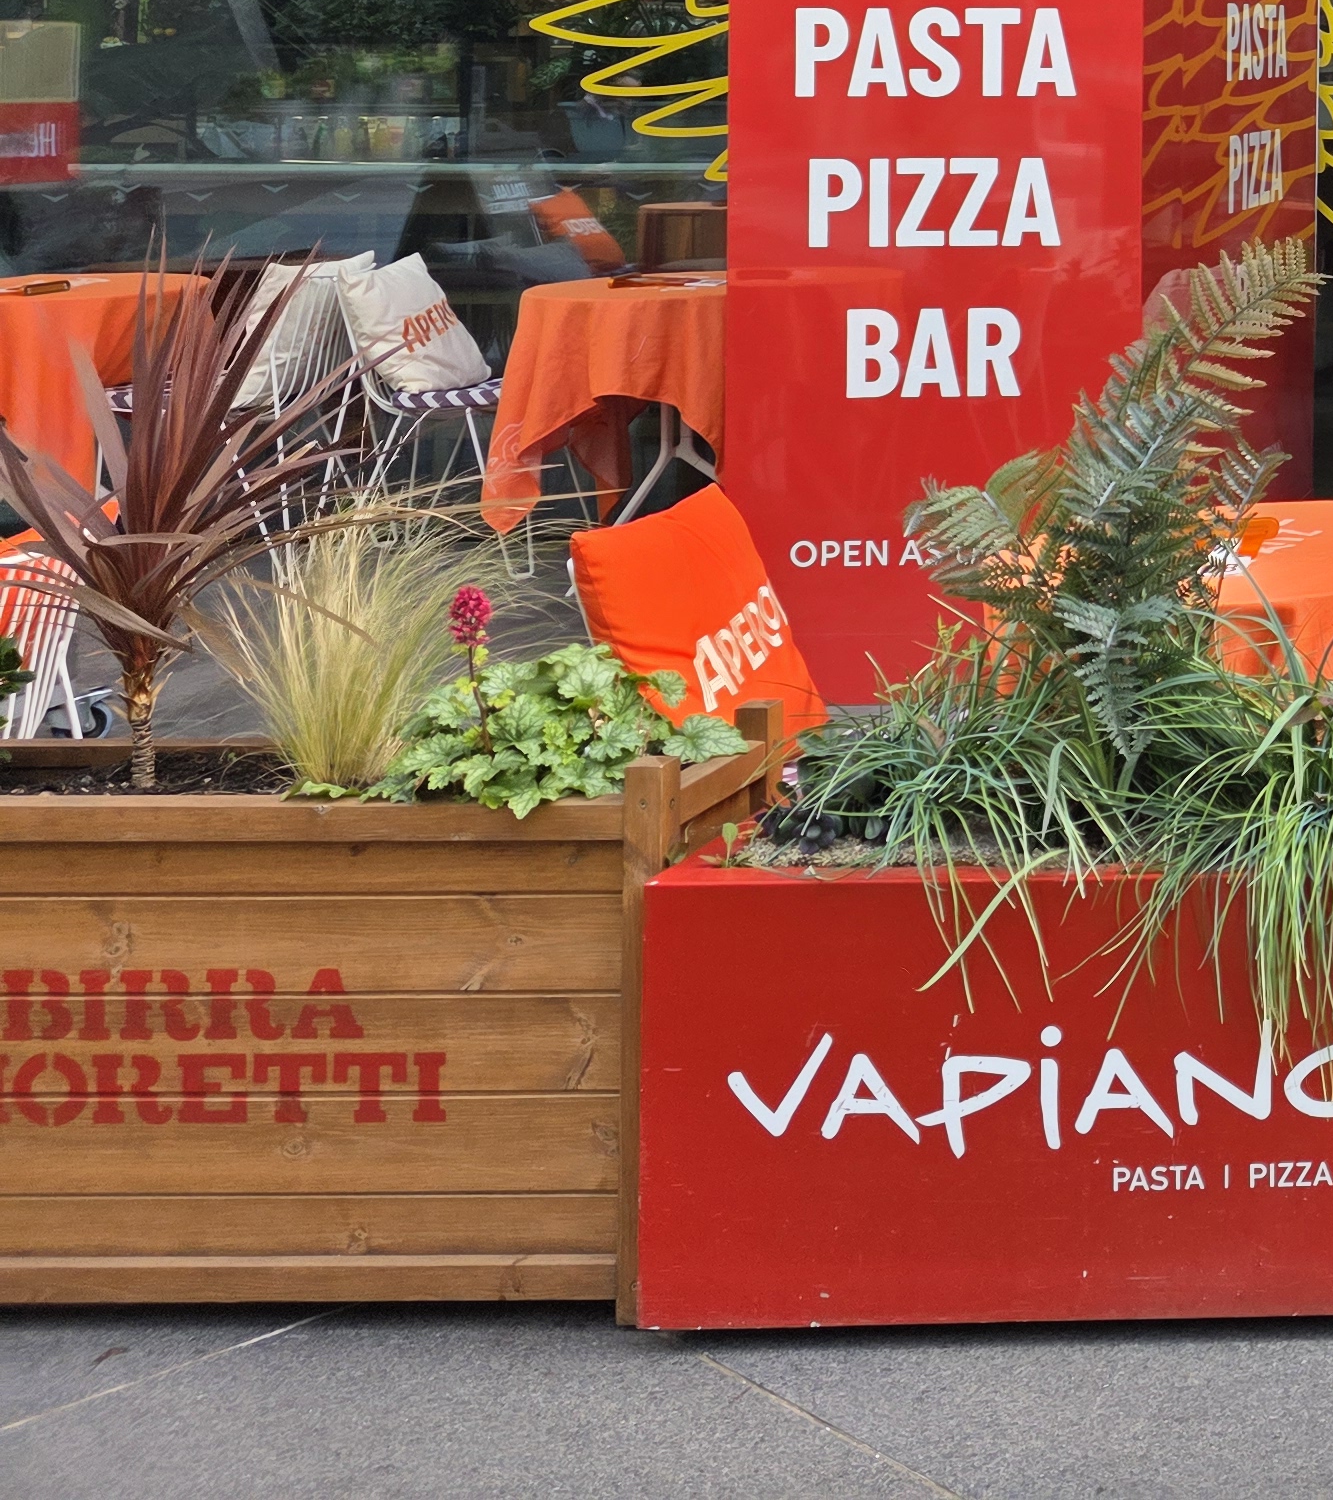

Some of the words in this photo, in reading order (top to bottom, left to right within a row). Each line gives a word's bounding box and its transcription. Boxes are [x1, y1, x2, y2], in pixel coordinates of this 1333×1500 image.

[794, 6, 1077, 98] PASTA
[1226, 2, 1288, 82] PASTA
[807, 156, 1062, 248] PIZZA
[1227, 128, 1284, 215] PIZZA
[844, 307, 1022, 399] BAR
[789, 539, 889, 568] OPEN
[2, 967, 365, 1043] BIRRA
[0, 1051, 447, 1128] ORETTI
[1112, 1164, 1205, 1193] PASTA
[1248, 1161, 1333, 1190] PIZZA
